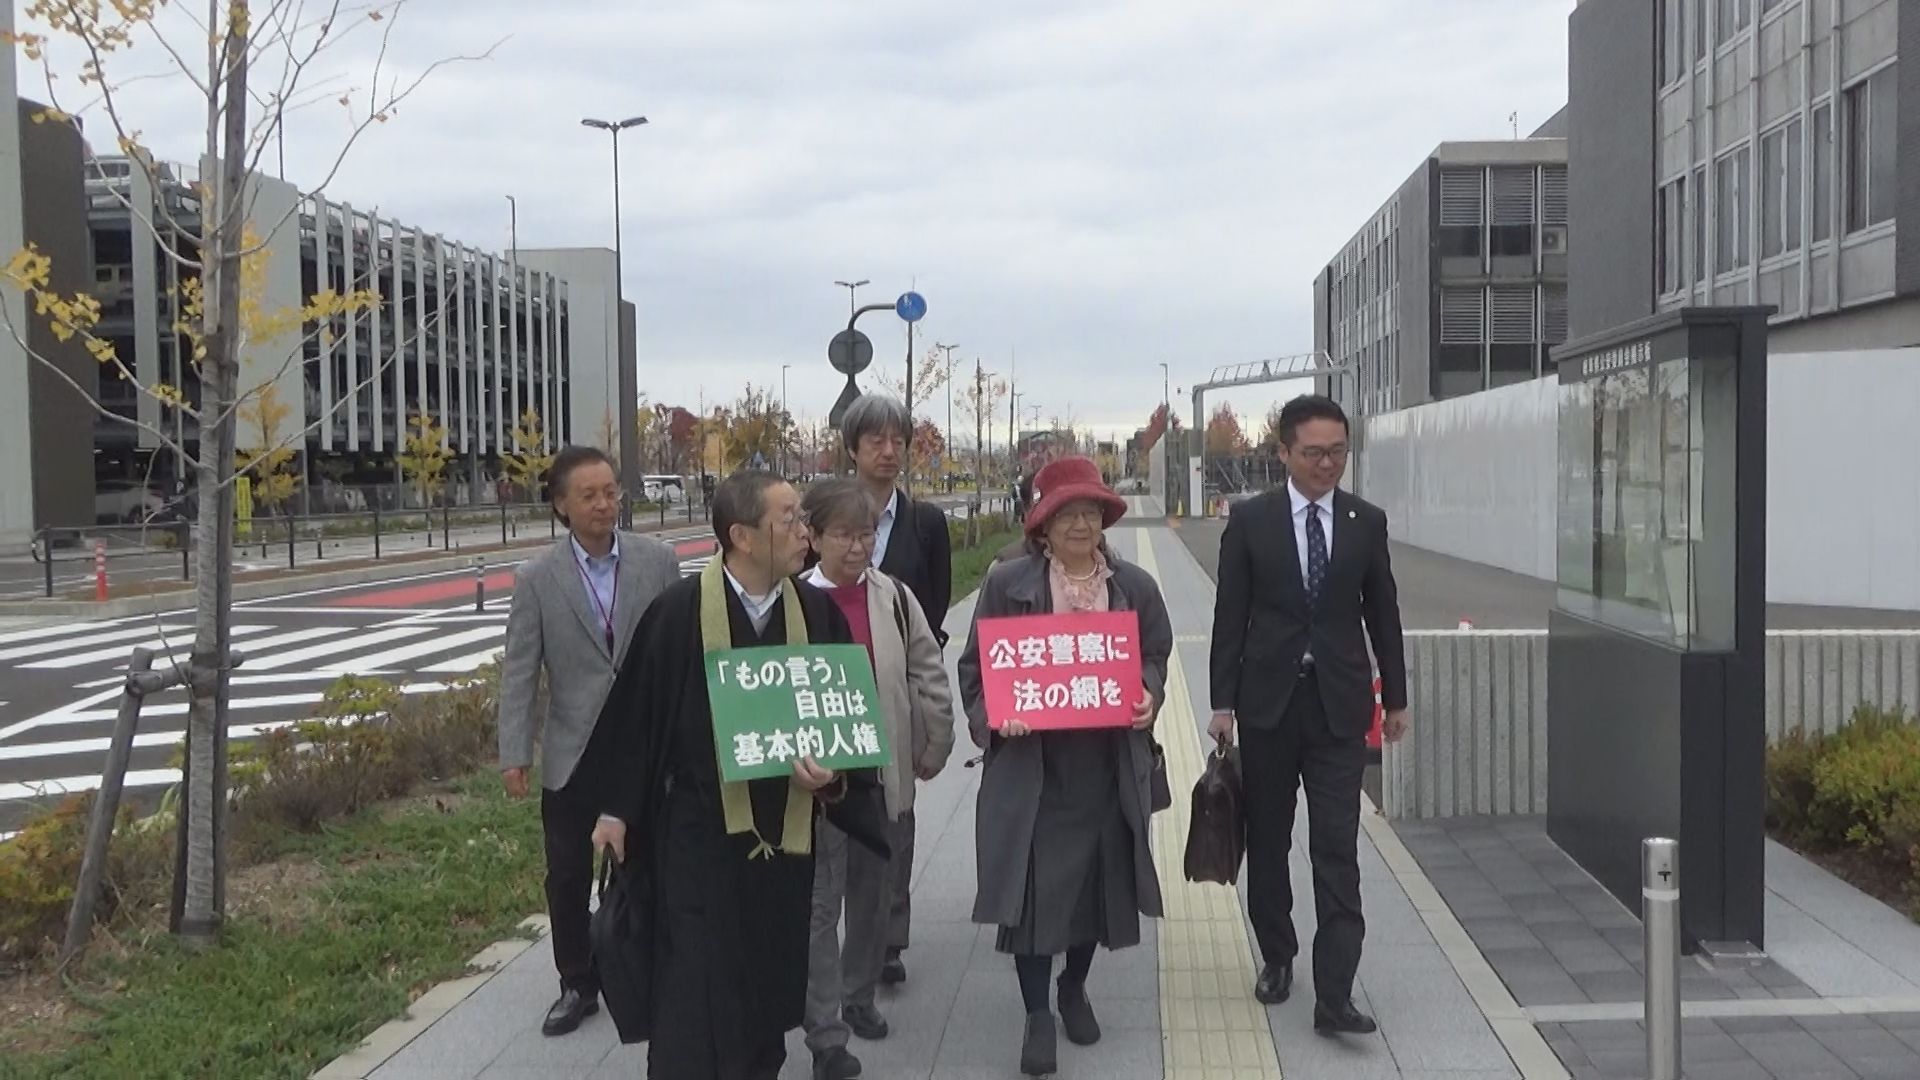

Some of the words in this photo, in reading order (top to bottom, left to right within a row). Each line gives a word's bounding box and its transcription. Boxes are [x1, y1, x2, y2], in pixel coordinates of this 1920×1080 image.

[988, 632, 1130, 669] 公安警察に
[717, 656, 847, 690] 「もの言う」
[794, 687, 868, 720] 自由は
[1012, 675, 1122, 712] 法の網を
[733, 722, 881, 767] 基本的人権
